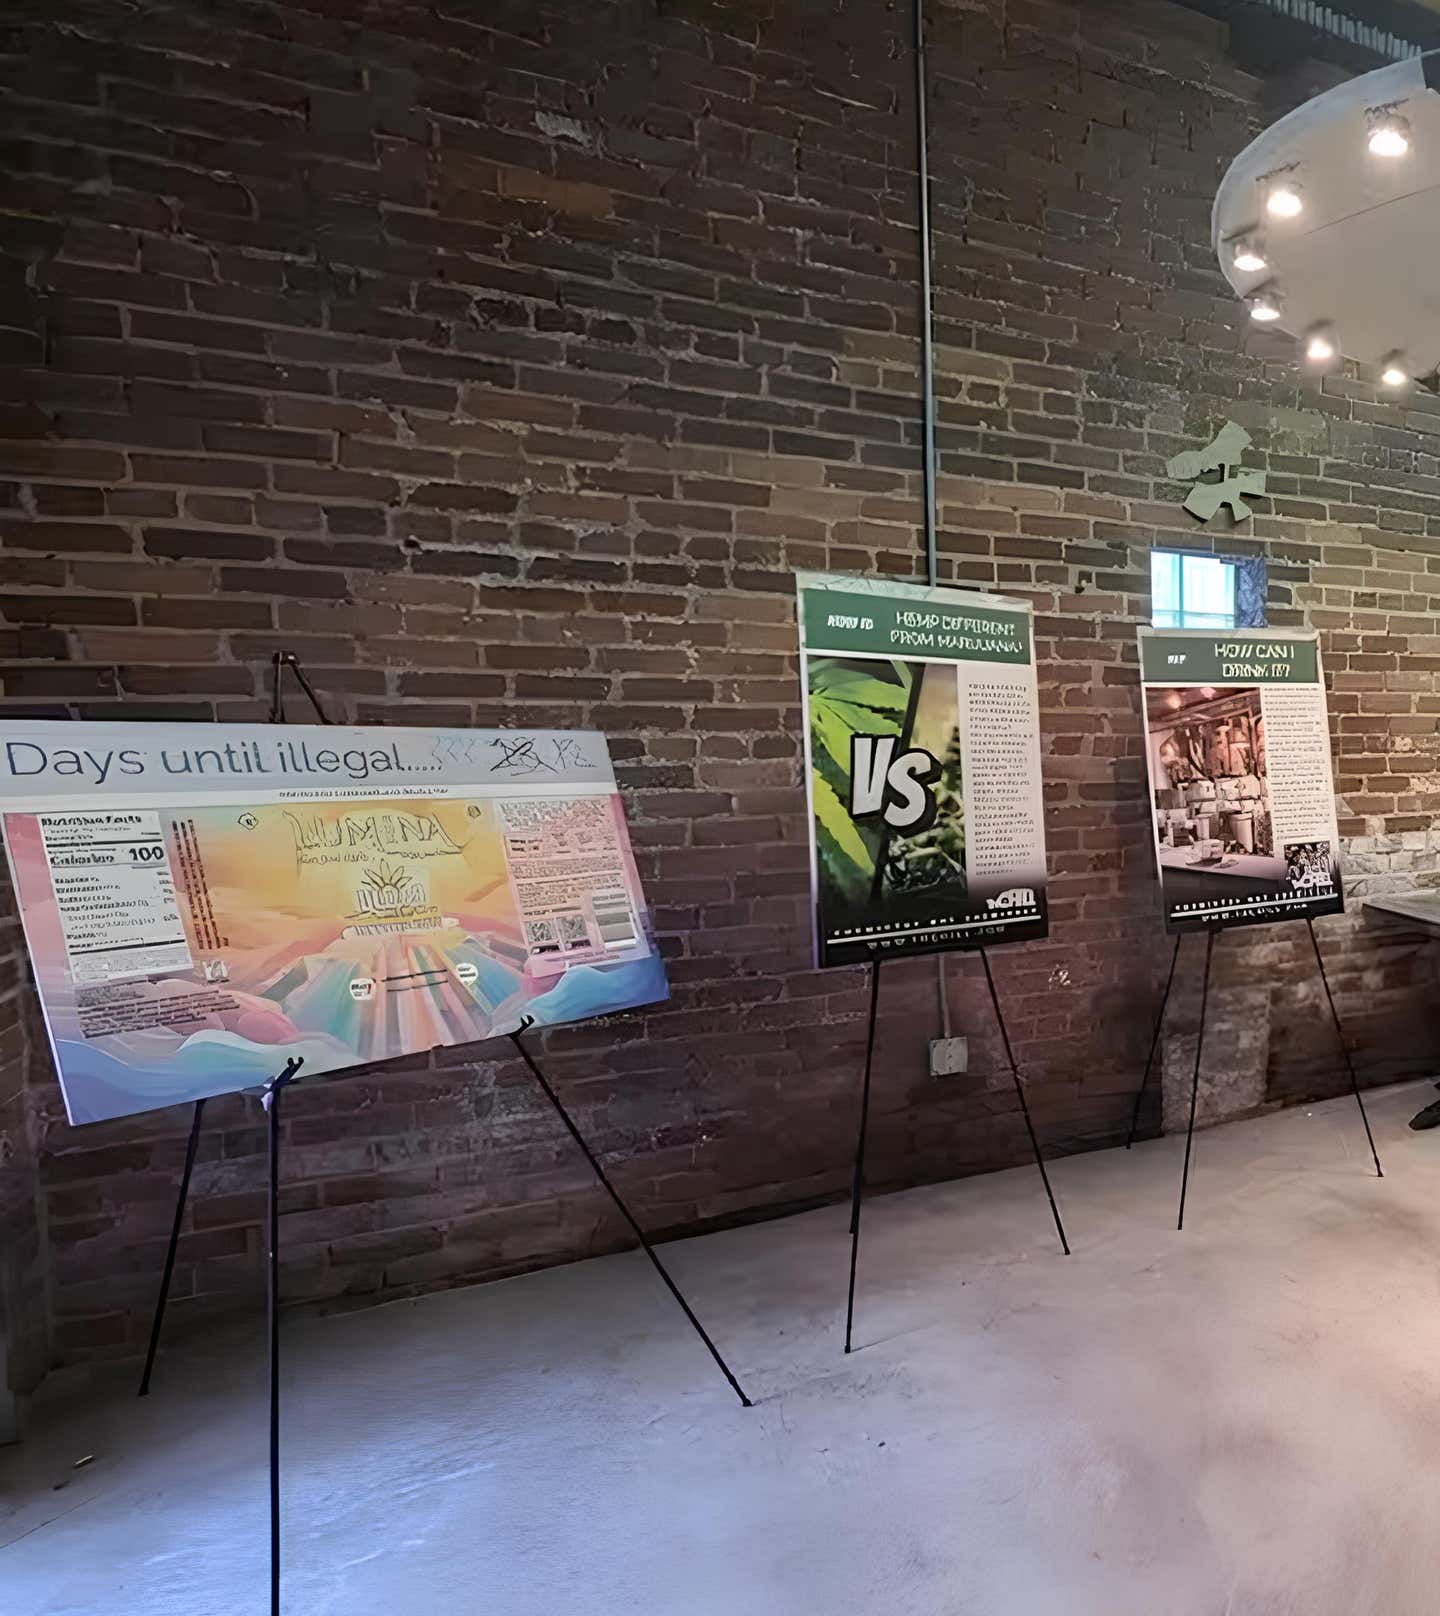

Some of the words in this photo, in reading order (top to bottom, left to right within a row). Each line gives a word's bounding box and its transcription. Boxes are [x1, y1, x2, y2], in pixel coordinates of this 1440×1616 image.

[1256, 644, 1287, 658] CAN
[6, 741, 146, 785] Days
[161, 740, 267, 774] until
[852, 737, 932, 827] VS
[129, 845, 164, 861] 100
